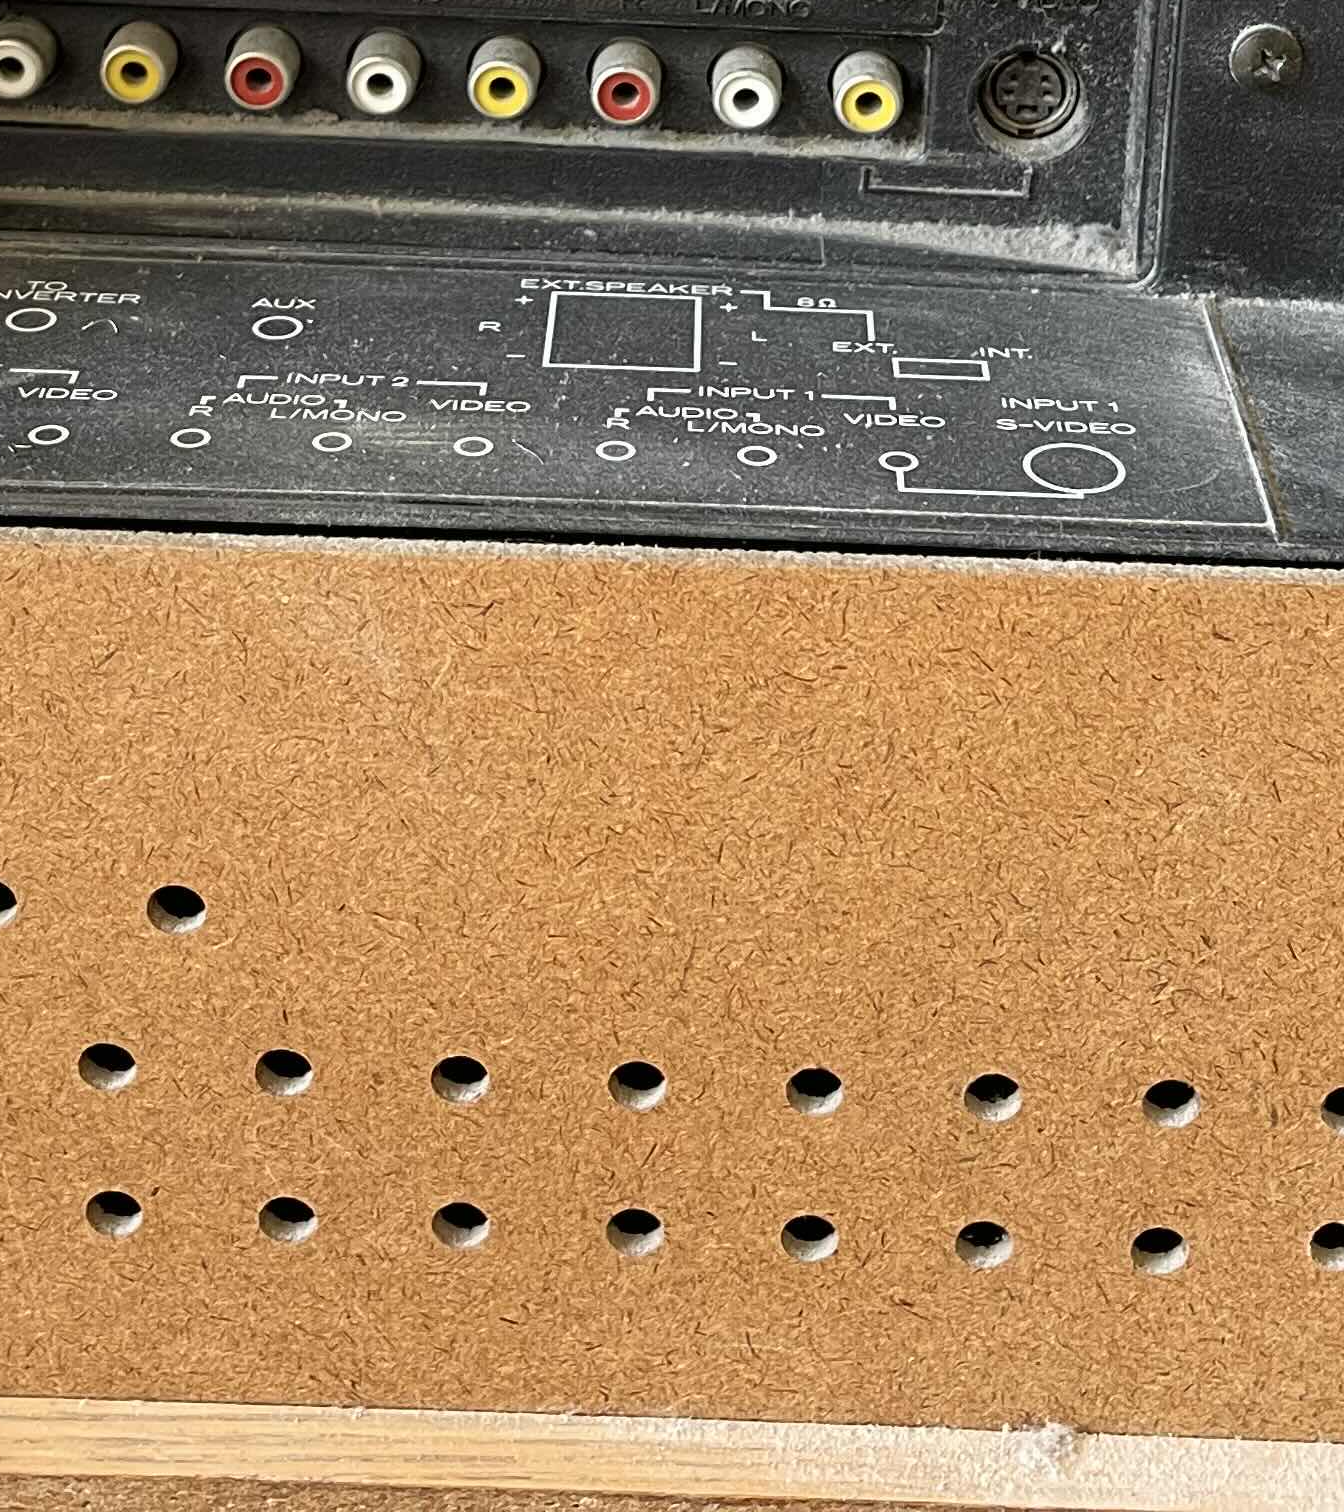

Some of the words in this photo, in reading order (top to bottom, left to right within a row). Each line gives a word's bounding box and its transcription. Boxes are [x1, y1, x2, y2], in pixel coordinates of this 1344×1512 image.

[26, 280, 68, 291] TO
[251, 297, 317, 310] AUX
[477, 320, 502, 333] R
[751, 330, 768, 342] L
[831, 340, 898, 355] EXT.
[978, 346, 1033, 360] INT.
[285, 372, 386, 388] INPUT
[390, 376, 410, 388] 2
[16, 386, 119, 402] VIDEO
[222, 391, 326, 407] AUDIO
[697, 384, 796, 401] INPUT
[804, 389, 815, 402] 1
[429, 397, 532, 414] VIDEO
[634, 404, 739, 420] AUDIO
[1000, 396, 1100, 413] INPUT
[1108, 400, 1120, 414] 1
[188, 404, 214, 418] R
[269, 406, 408, 423] L/MONO
[843, 412, 947, 430] VIDEO
[605, 416, 632, 430] R
[686, 420, 826, 438] L/MONO
[995, 417, 1138, 436] S-VIDEO
